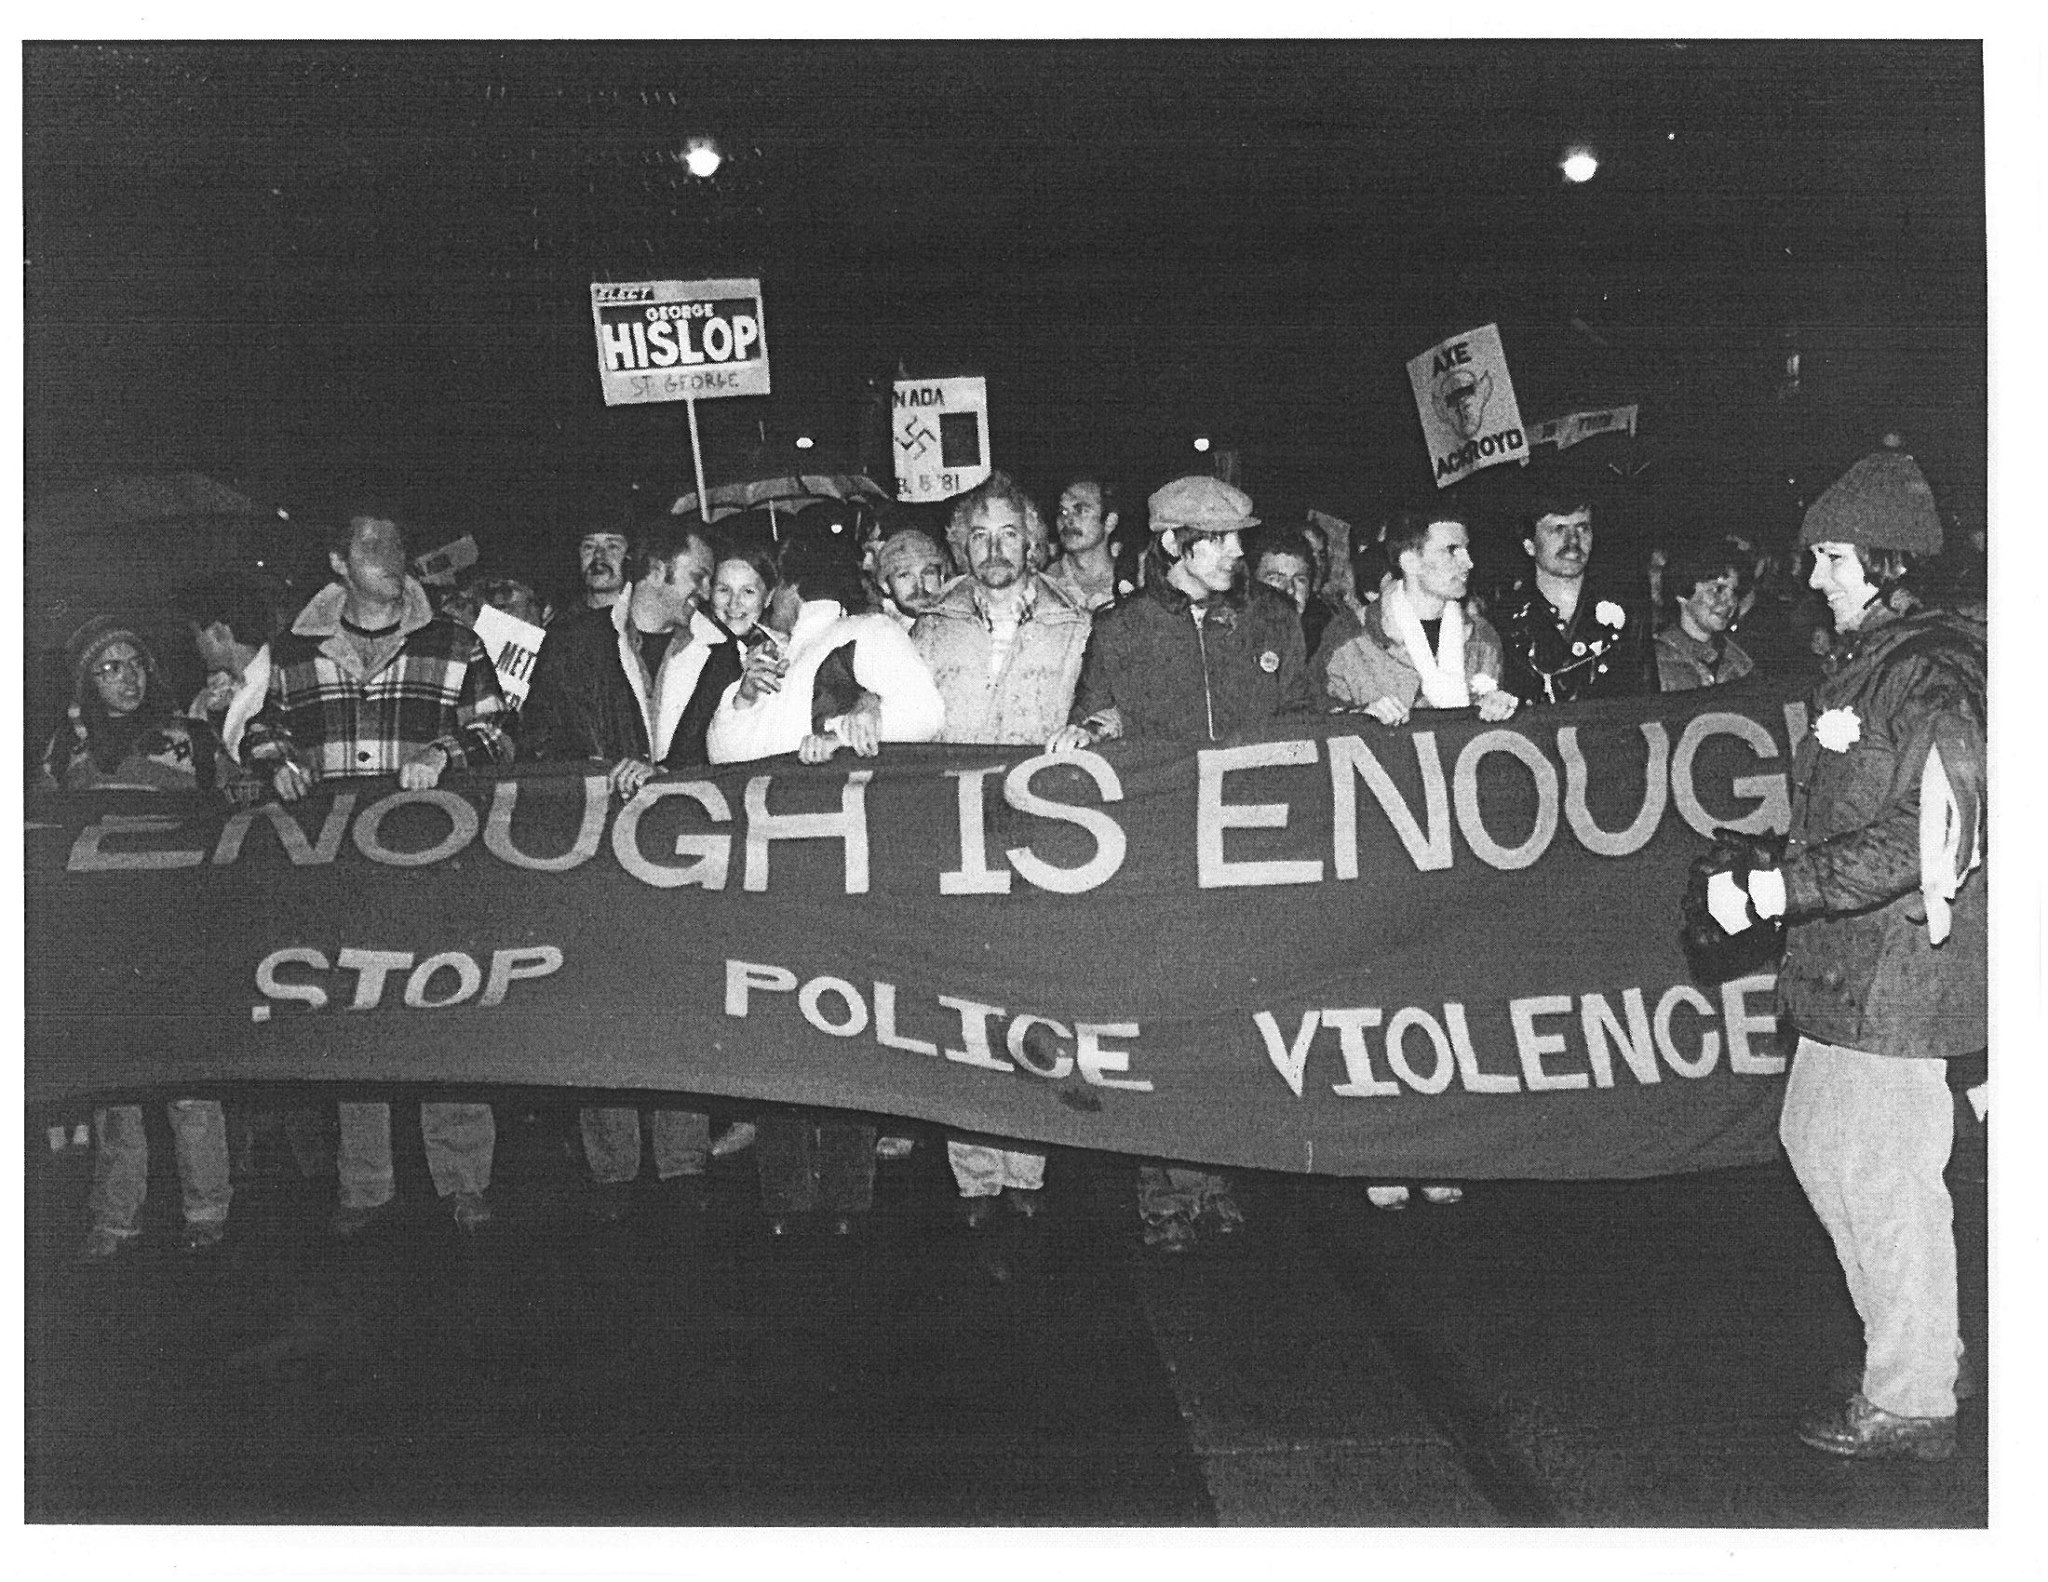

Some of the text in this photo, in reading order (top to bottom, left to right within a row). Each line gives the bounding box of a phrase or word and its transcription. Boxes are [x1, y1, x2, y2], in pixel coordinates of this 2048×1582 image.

[599, 286, 653, 301] ELECT
[645, 303, 715, 321] GEORGE
[602, 314, 758, 371] HISLOP
[1433, 341, 1473, 377] AXE
[664, 372, 739, 393] GEORGE
[1436, 429, 1523, 480] ACKROYD
[66, 769, 873, 894] ENOUGH
[939, 748, 1127, 894] IS
[251, 945, 1787, 1097] STOP POLICE VIOLENCE
